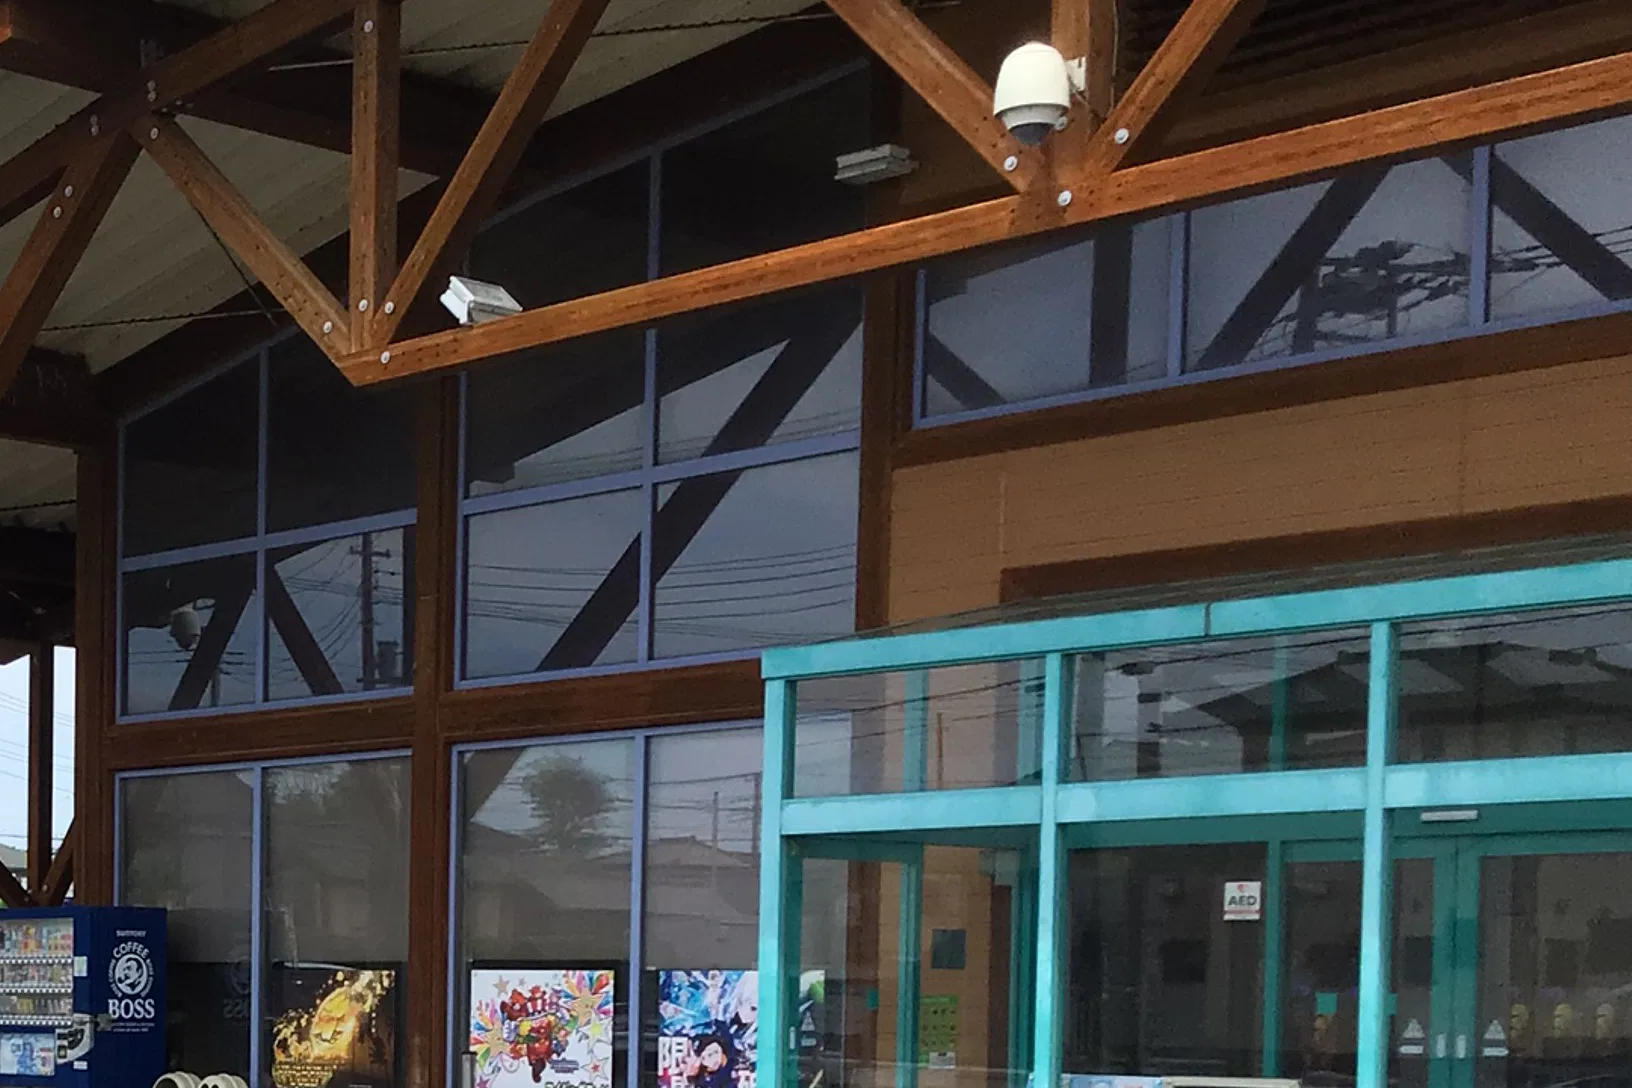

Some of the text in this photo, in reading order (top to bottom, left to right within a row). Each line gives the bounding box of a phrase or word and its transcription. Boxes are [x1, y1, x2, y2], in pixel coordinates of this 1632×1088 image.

[1228, 895, 1258, 906] AED
[113, 941, 149, 958] COFFEE
[108, 999, 155, 1018] BOSS
